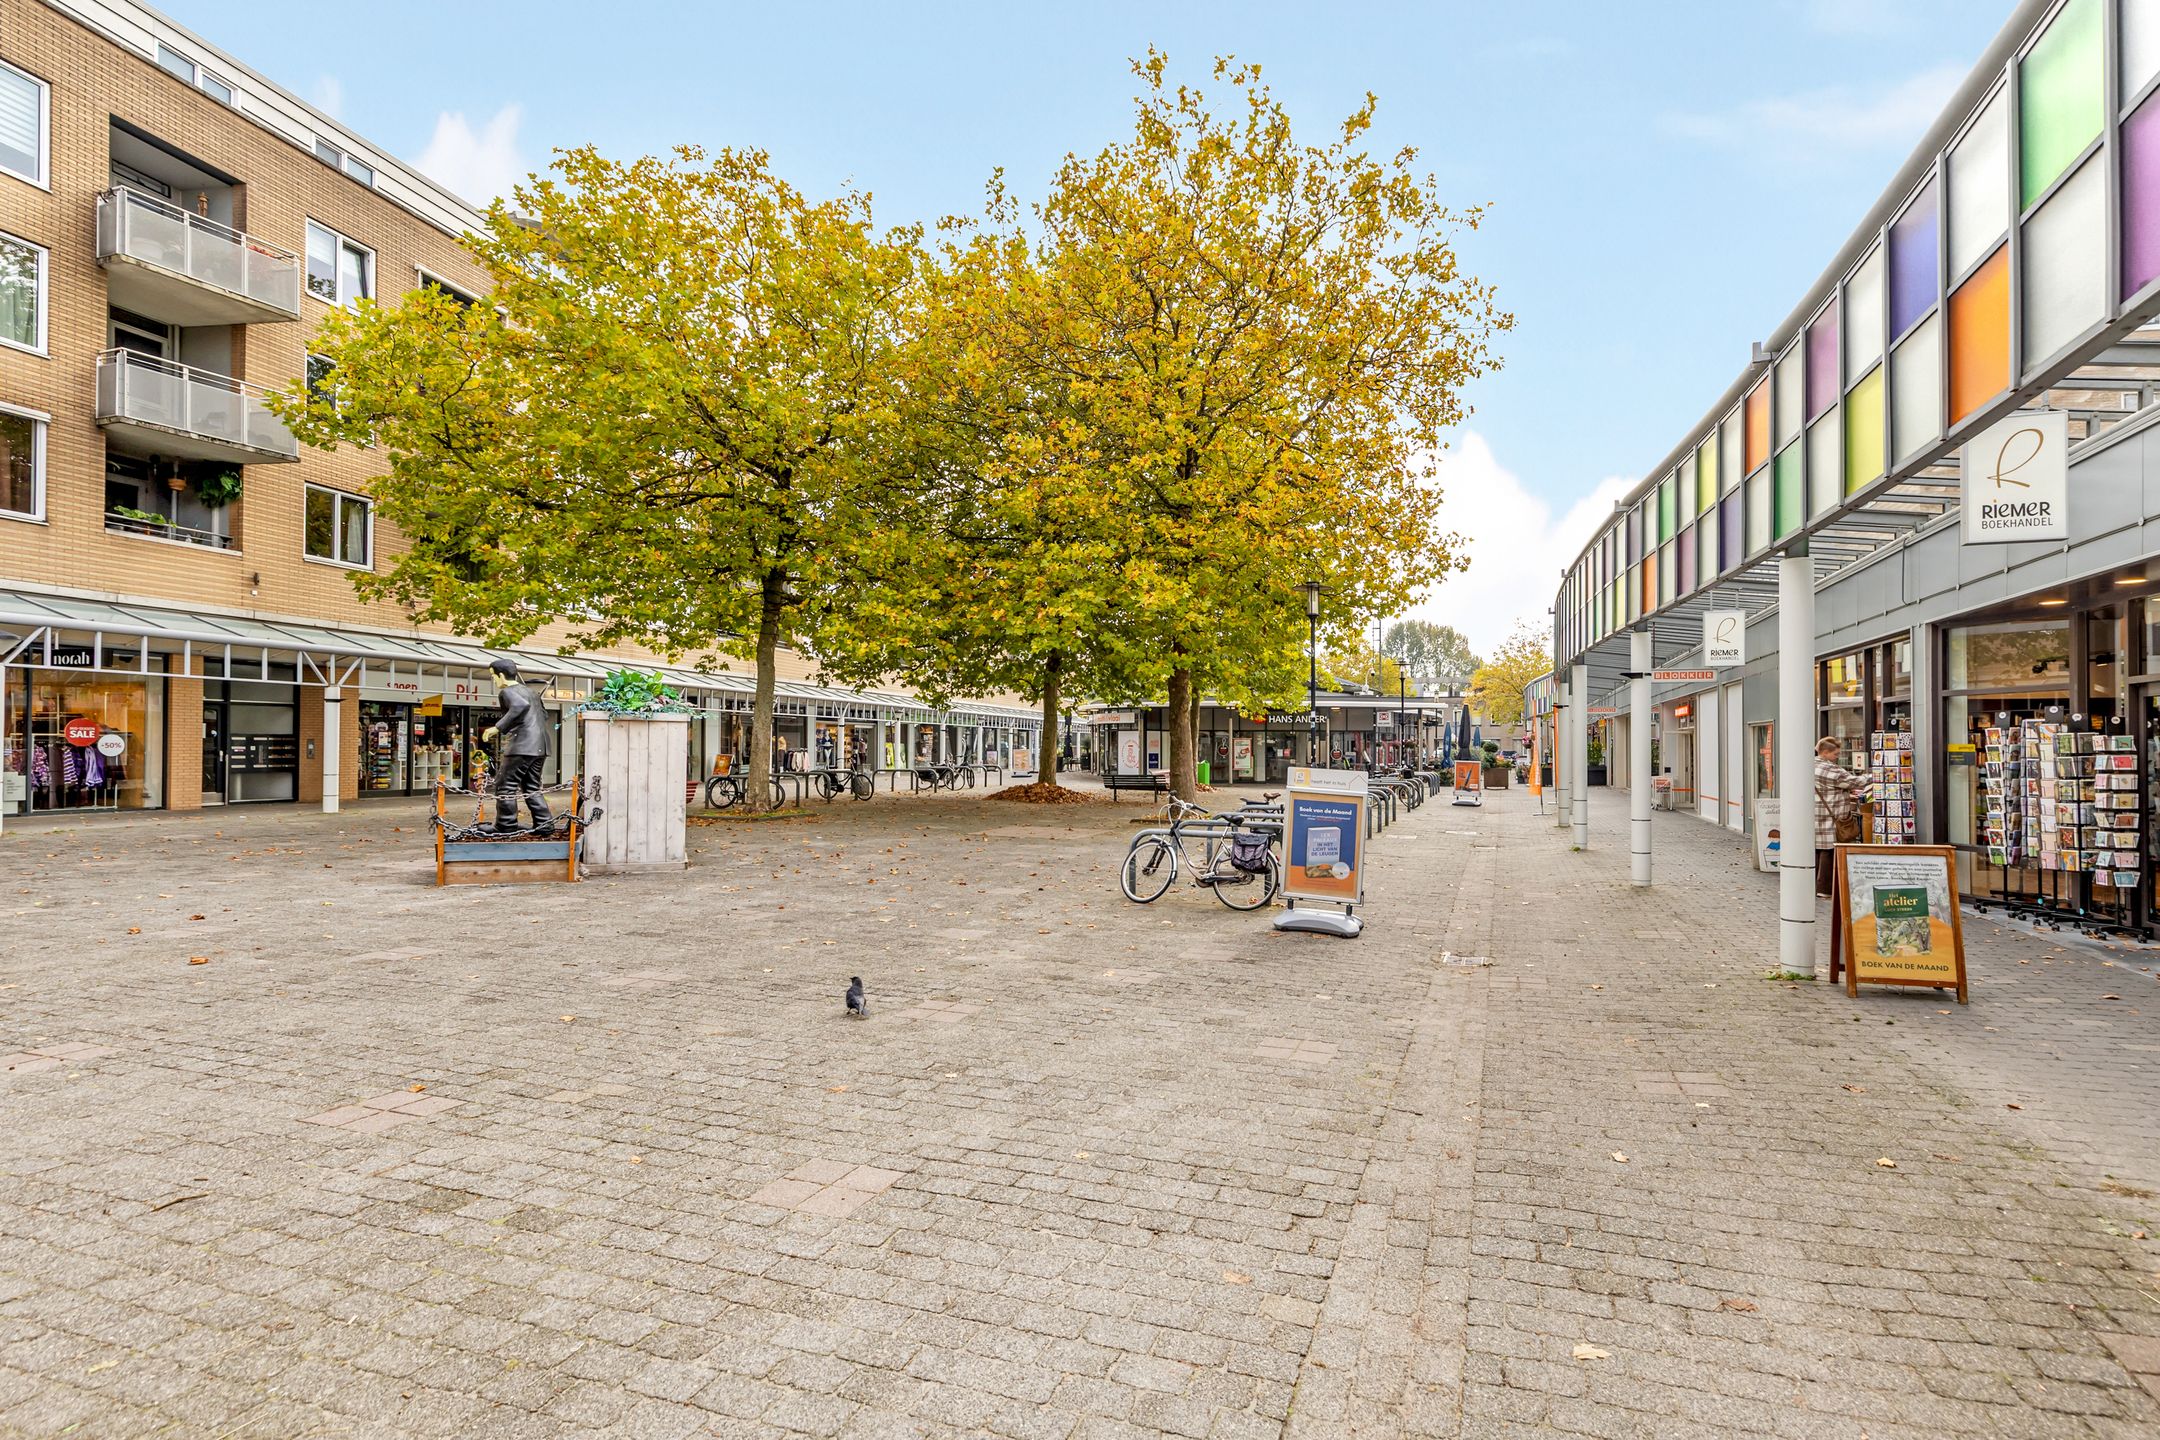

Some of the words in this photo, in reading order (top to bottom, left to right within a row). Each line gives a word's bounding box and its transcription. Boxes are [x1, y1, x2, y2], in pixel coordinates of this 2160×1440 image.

[1981, 517, 2053, 530] BOEKHANDEL
[53, 651, 90, 665] norah
[1268, 715, 1293, 723] HANS
[1295, 715, 1327, 723] ANER
[69, 730, 96, 739] SALE
[1883, 896, 1919, 907] atelier
[1861, 961, 1884, 969] BOEK
[1916, 963, 1949, 972] MAAND
